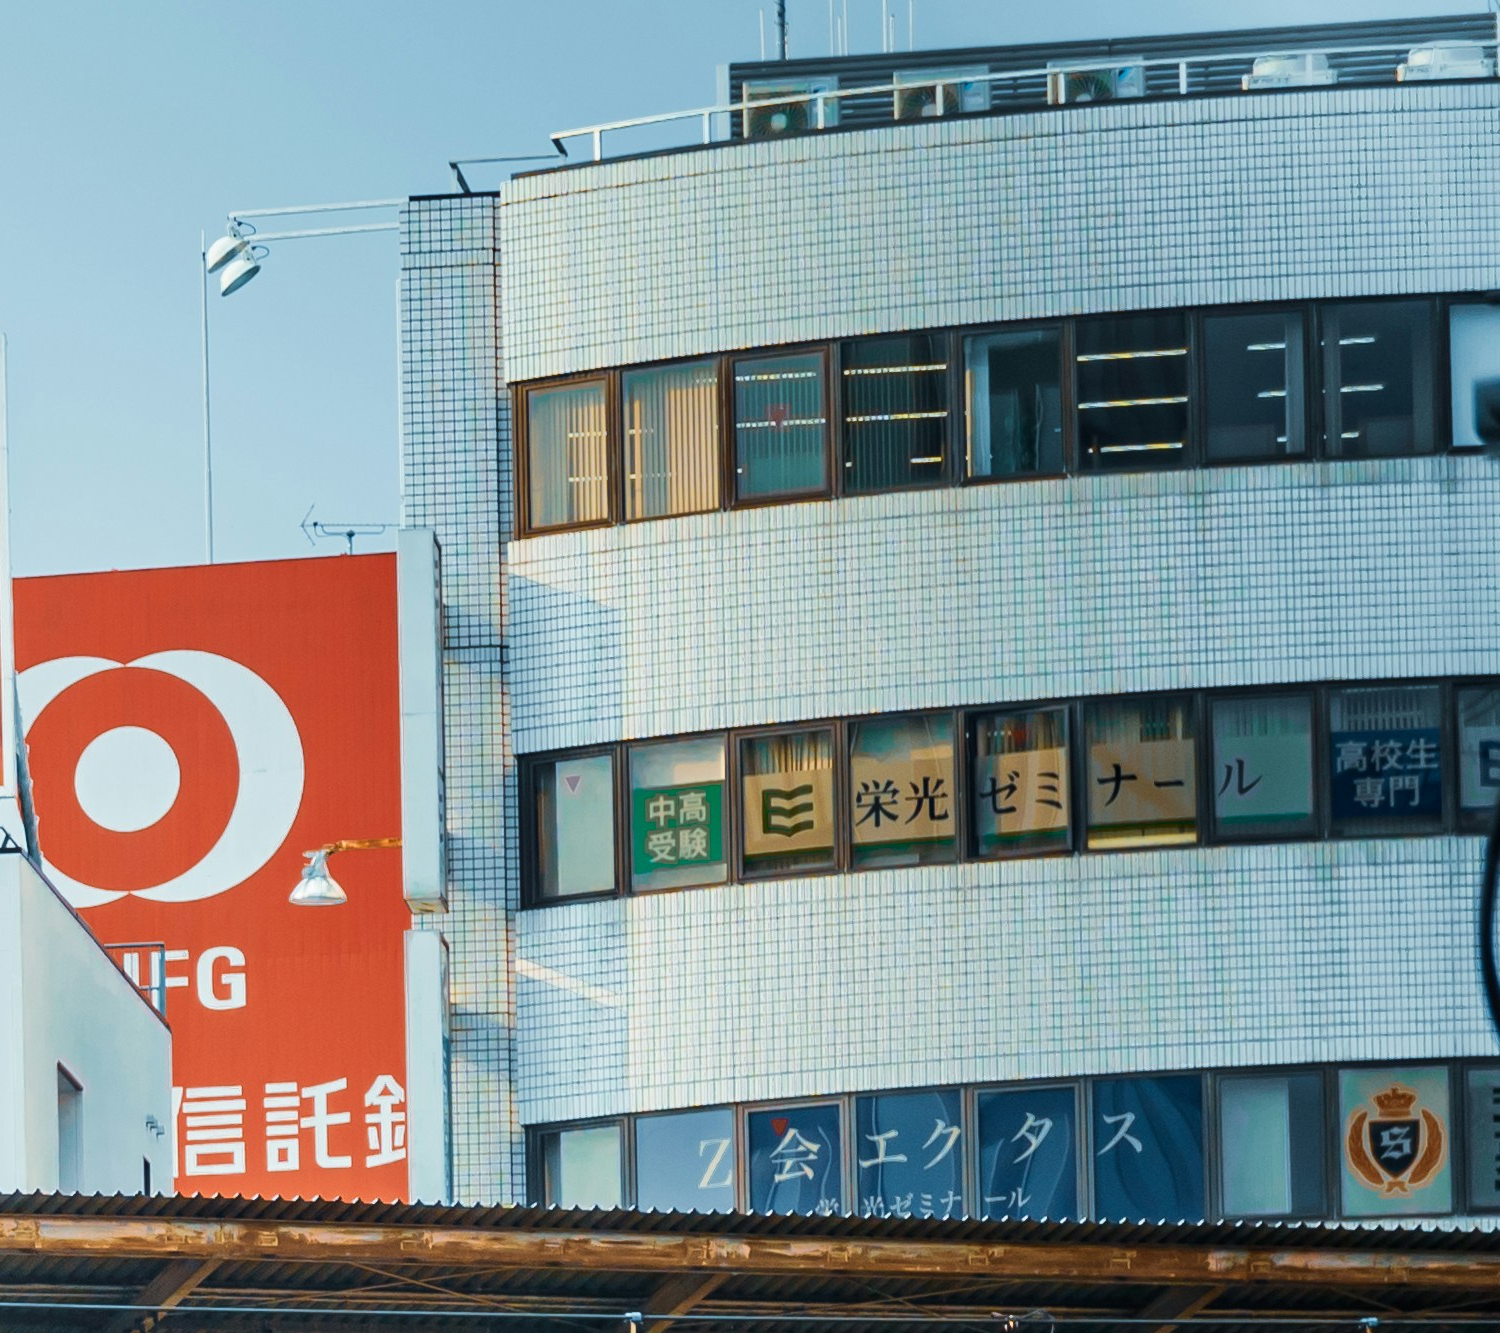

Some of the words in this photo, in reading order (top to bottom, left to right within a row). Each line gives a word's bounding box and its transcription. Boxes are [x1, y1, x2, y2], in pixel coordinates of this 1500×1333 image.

[1335, 738, 1439, 772] 高校生
[855, 757, 1263, 828] 栄光ゼミナール
[1353, 775, 1421, 808] 専門
[649, 792, 707, 828] 中高
[648, 828, 707, 863] 受験
